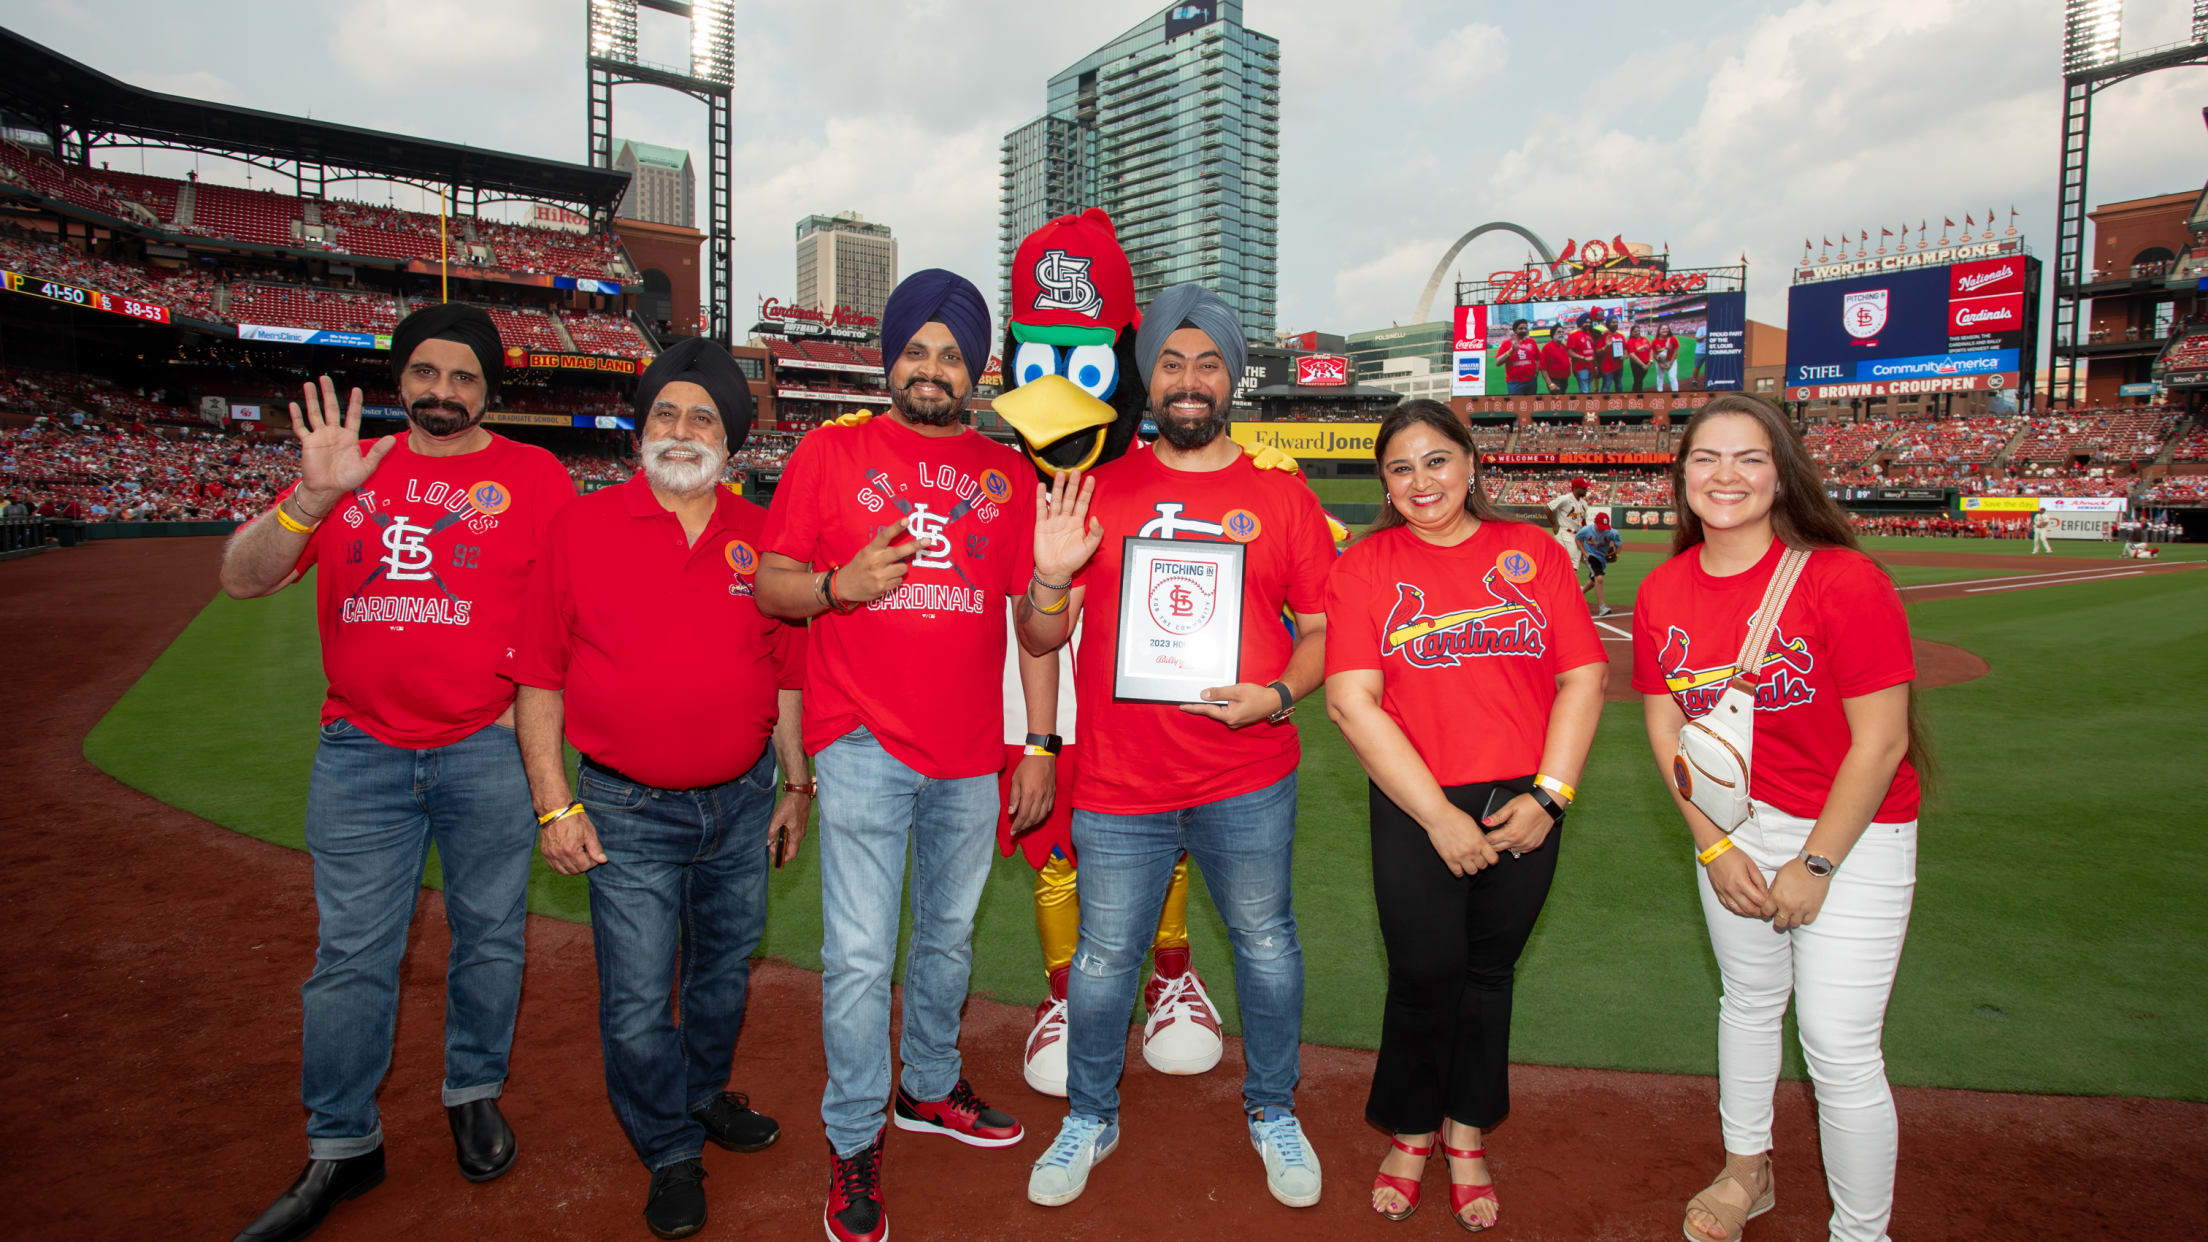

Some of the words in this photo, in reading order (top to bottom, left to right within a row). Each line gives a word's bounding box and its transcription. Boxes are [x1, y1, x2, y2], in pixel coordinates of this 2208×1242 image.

[536, 205, 590, 227] Hilton
[1812, 260, 1877, 280] WORLD
[1881, 242, 2001, 270] CHAMPIONS
[1488, 265, 1708, 304] Budweiser
[1958, 264, 2014, 292] Nationals
[40, 282, 85, 304] 41-50
[1846, 293, 1880, 303] PITCHING
[124, 300, 162, 321] 38-53
[762, 297, 826, 322] Cardinals
[824, 304, 877, 328] Nation
[1955, 307, 2012, 327] Cardinals
[530, 354, 559, 367] BIG
[561, 355, 596, 369] MAC
[597, 357, 635, 374] LAND
[1800, 365, 1843, 380] STIFEL
[1819, 384, 1872, 398] BROWN
[1875, 386, 1885, 395] &
[1889, 378, 1974, 394] CROUPPEN
[1256, 431, 1324, 450] Edward
[1327, 432, 1375, 452] Jone
[1559, 453, 1602, 463] BUSCH
[1607, 453, 1671, 463] STADIUM
[857, 472, 909, 512] ST.
[918, 462, 1000, 524] LOUIS
[343, 490, 391, 528] ST.
[406, 479, 499, 534] LOUIS
[452, 544, 480, 569] 92
[966, 533, 989, 559] 92
[1154, 562, 1204, 576] PITCHING
[1206, 566, 1214, 576] IN
[343, 596, 472, 626] CARDINALS
[1149, 638, 1171, 648] 2023
[1402, 616, 1546, 669] Cardinals
